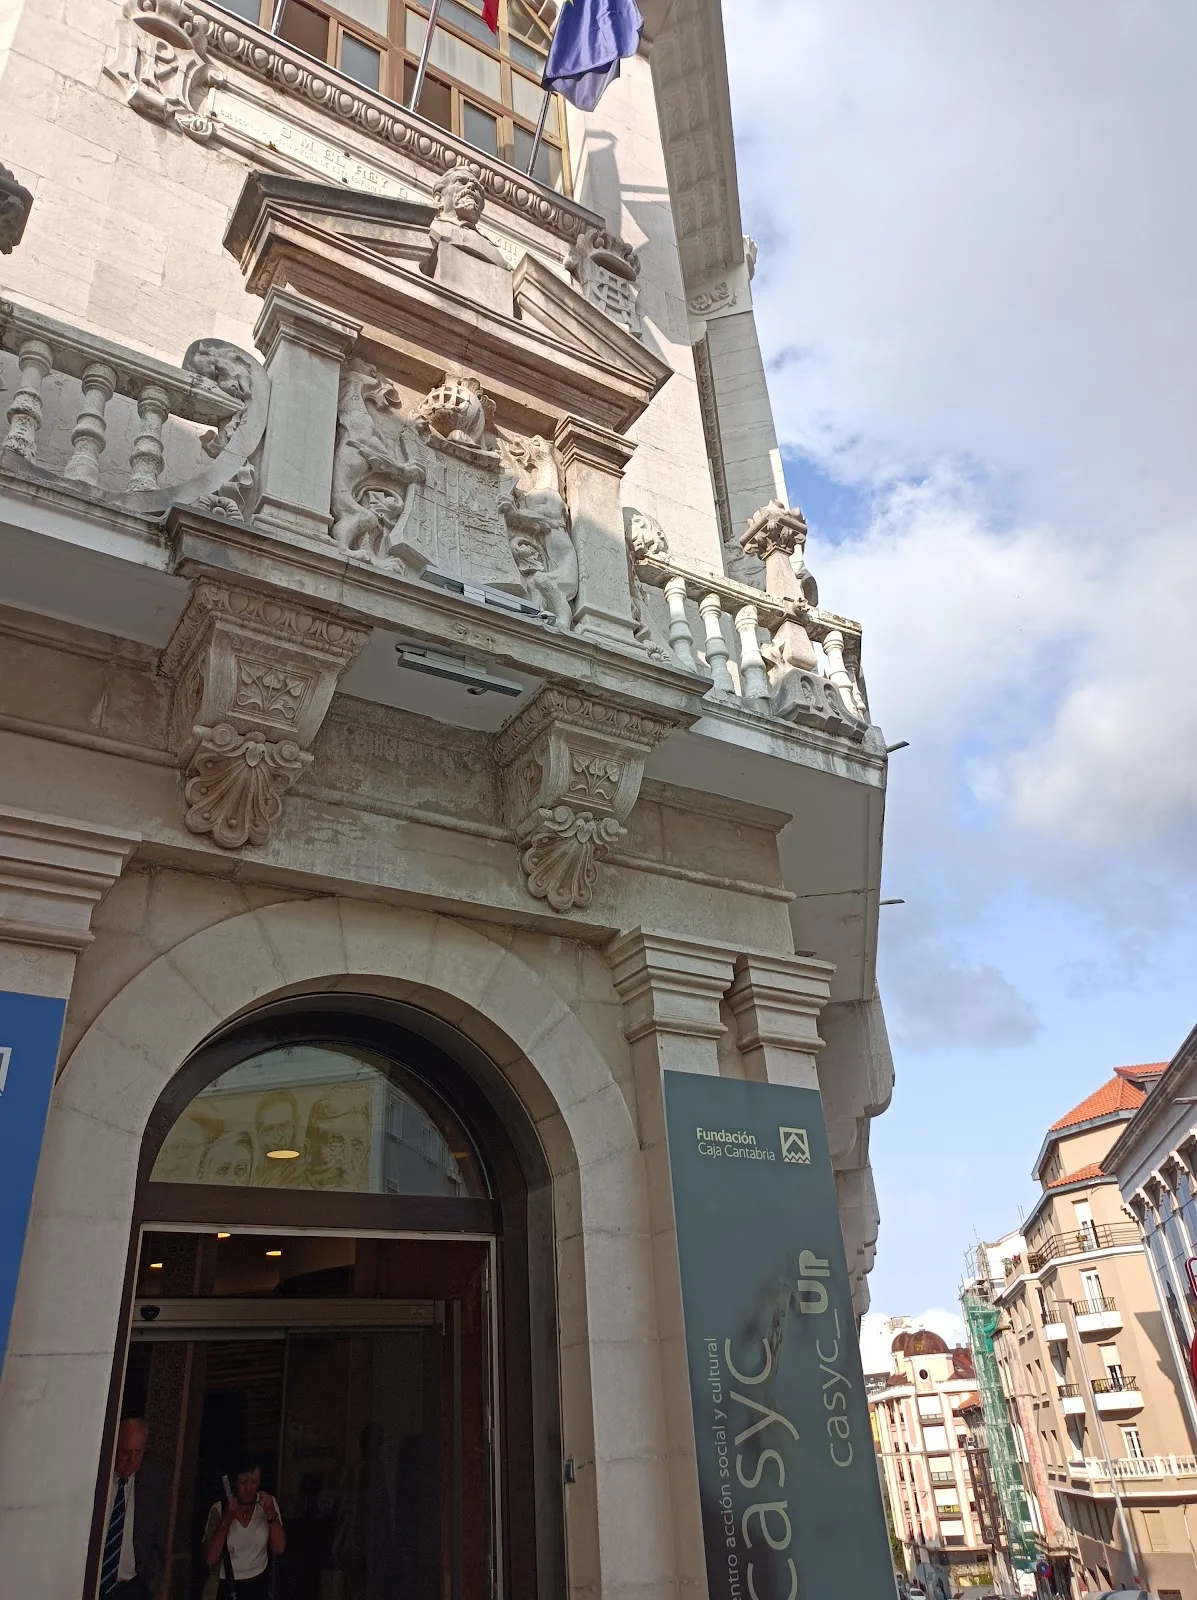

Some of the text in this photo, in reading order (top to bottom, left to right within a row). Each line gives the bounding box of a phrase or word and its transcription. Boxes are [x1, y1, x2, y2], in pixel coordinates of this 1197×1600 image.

[696, 1127, 757, 1145] Fundación
[698, 1142, 775, 1161] Caja Cantabria
[704, 1339, 723, 1403] cultural
[714, 1409, 727, 1420] y
[712, 1427, 730, 1478] social
[724, 1337, 800, 1600] casyc
[719, 1484, 737, 1548] acción
